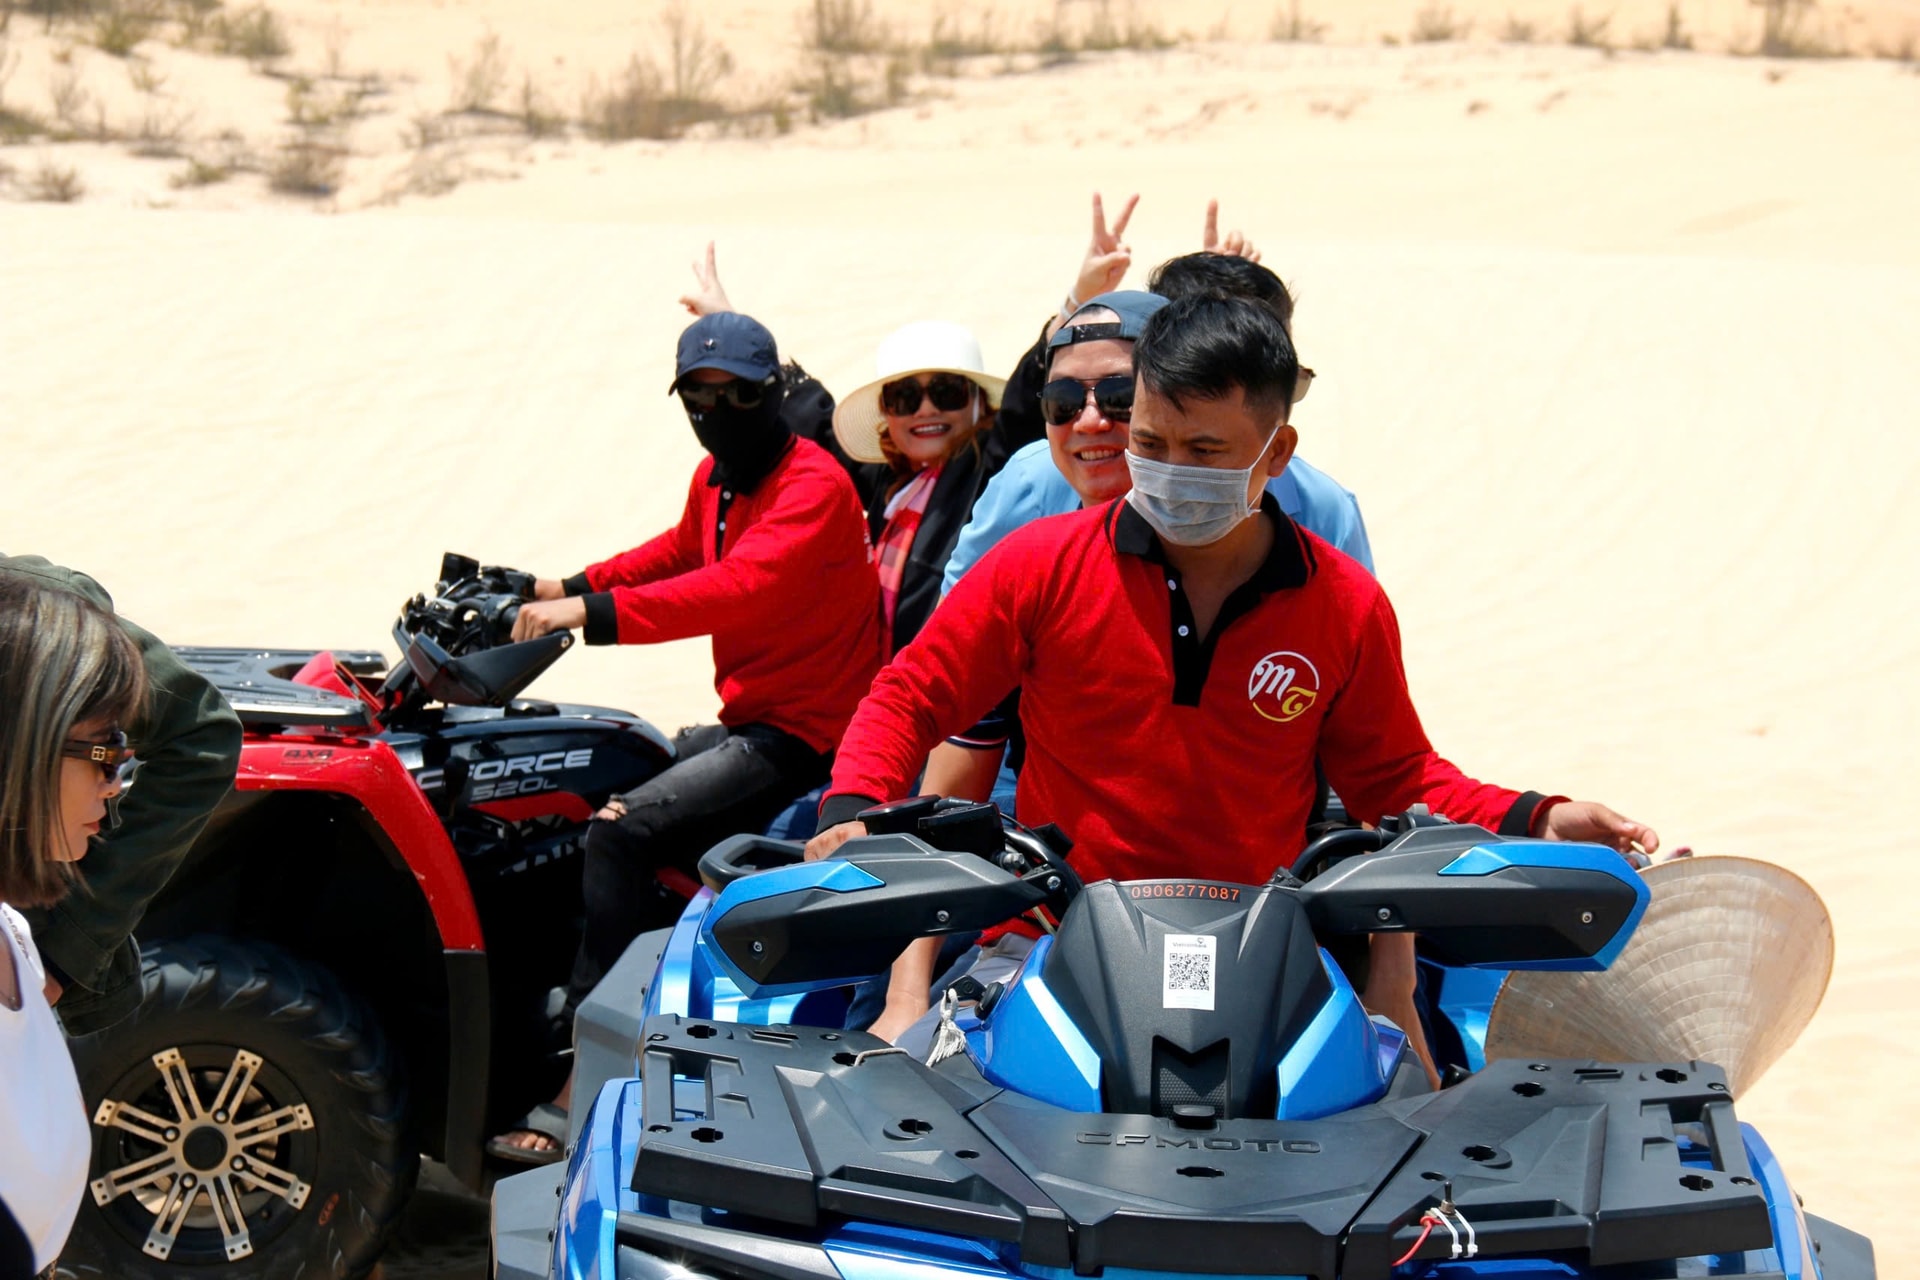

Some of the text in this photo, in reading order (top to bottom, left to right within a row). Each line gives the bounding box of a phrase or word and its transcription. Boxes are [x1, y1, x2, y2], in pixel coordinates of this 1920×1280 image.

[416, 749, 593, 789] CORCE
[470, 776, 558, 801] 520L
[1131, 884, 1240, 901] 0906277087
[1076, 1132, 1321, 1154] CFMOTO
